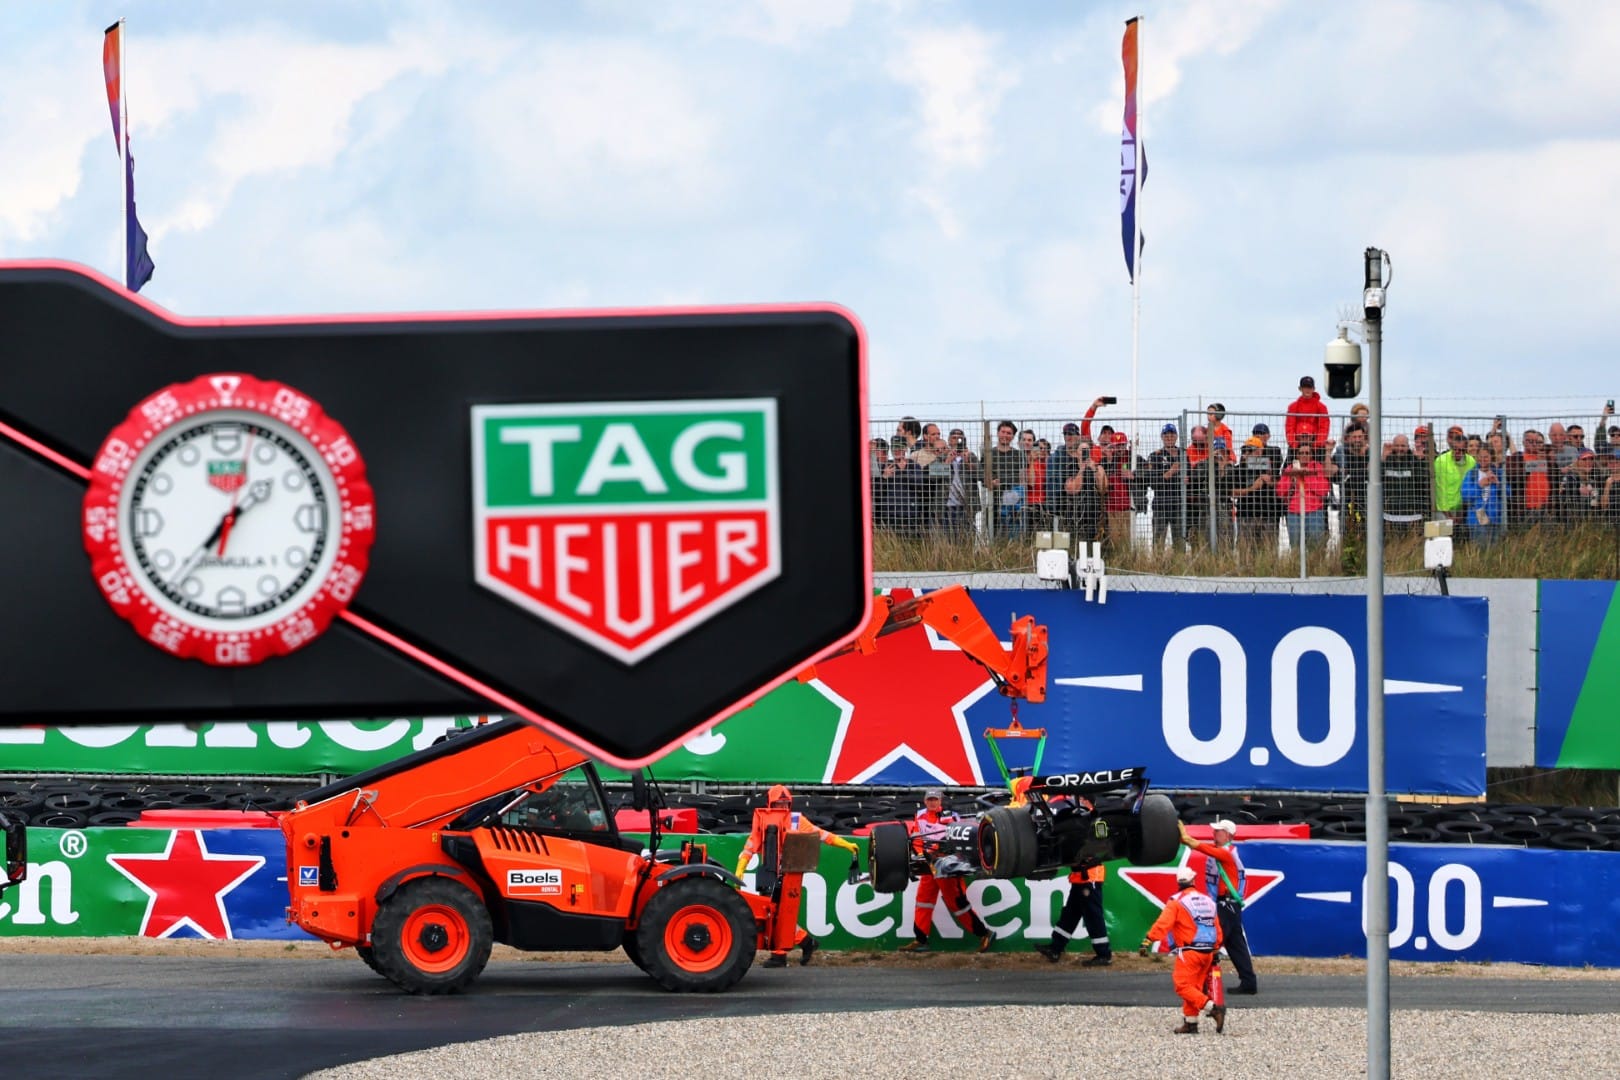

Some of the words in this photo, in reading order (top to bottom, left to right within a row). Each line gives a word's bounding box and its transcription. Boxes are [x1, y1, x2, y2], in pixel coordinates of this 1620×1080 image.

[97, 439, 128, 475] 50
[329, 435, 356, 466] 10
[499, 420, 748, 497] TAG
[496, 518, 758, 639] HEUER
[1161, 624, 1357, 767] 0.0
[1046, 768, 1134, 787] ORACLE
[510, 872, 559, 883] Boels
[1362, 861, 1482, 951] 0.0
